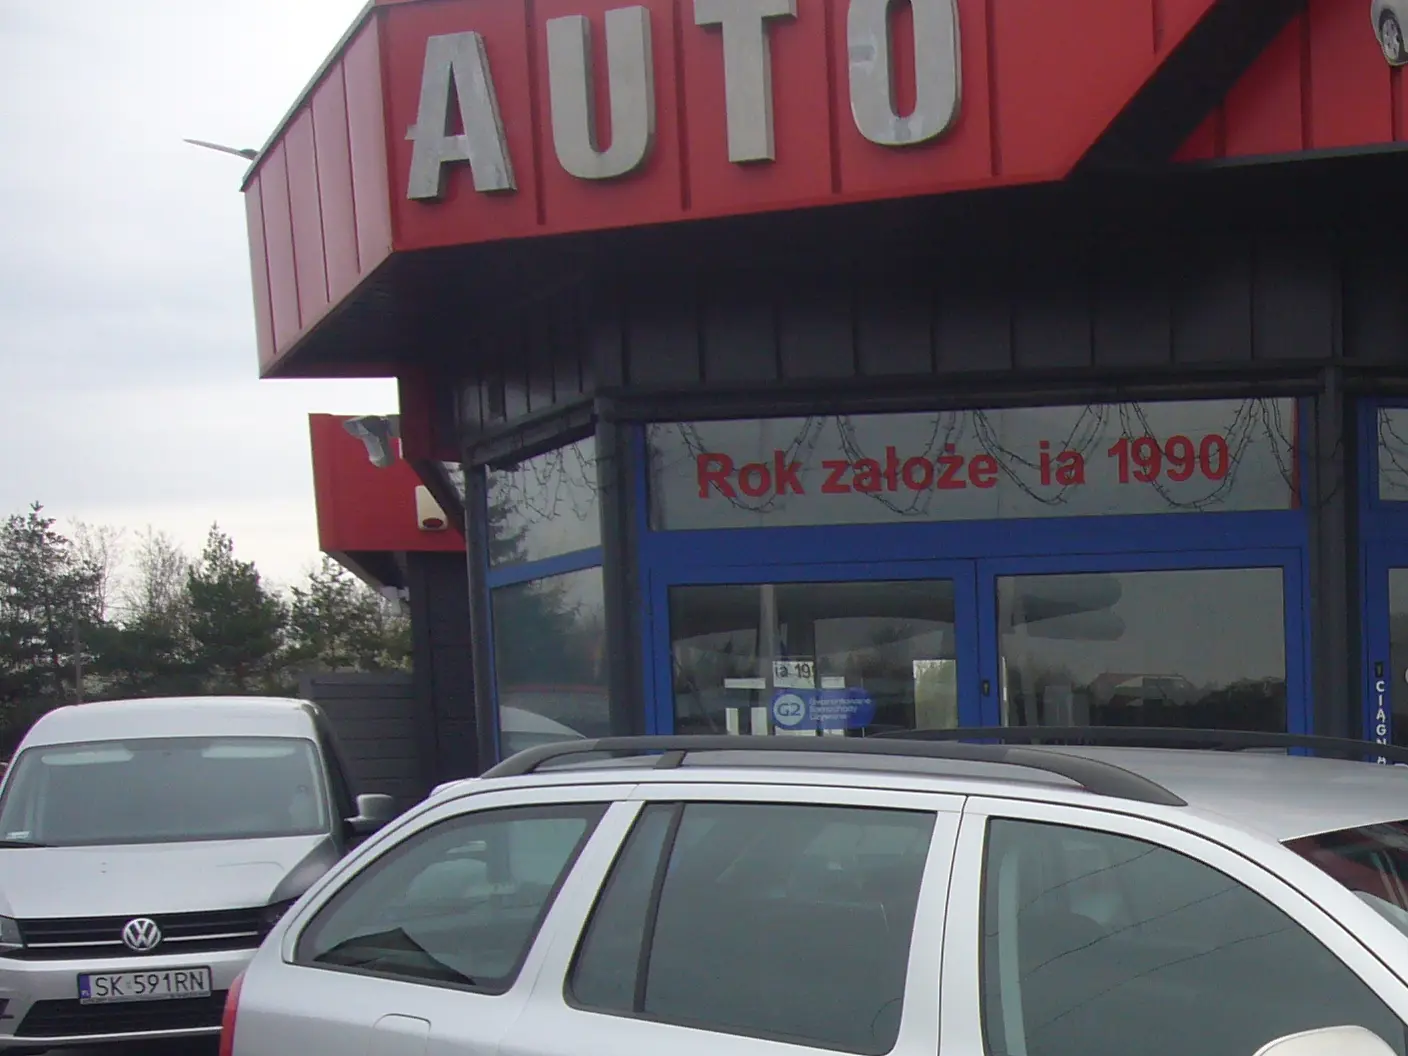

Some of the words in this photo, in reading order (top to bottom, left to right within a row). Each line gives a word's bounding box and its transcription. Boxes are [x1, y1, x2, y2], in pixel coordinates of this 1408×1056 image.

[405, 0, 962, 201] AUTO
[697, 449, 805, 498] Rok
[1107, 433, 1230, 485] 1990
[95, 975, 124, 996] SK
[133, 971, 205, 995] 591RN
